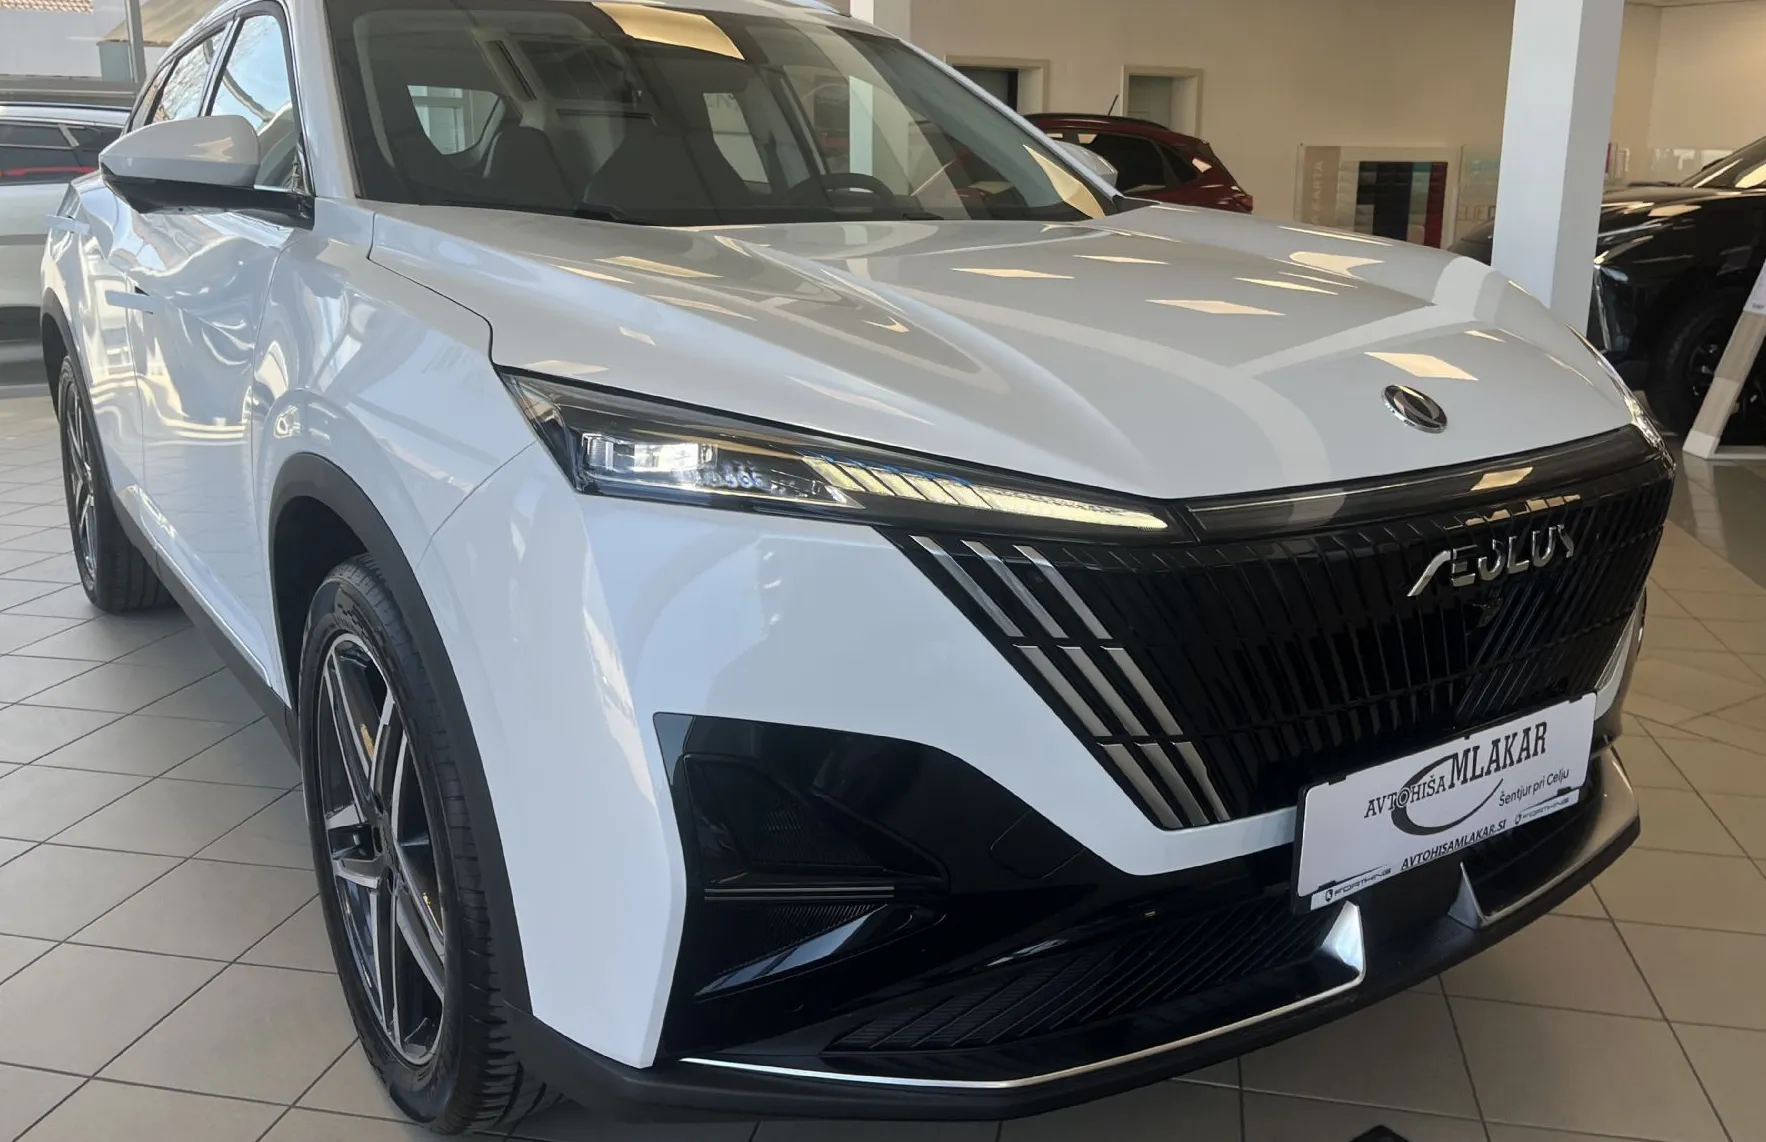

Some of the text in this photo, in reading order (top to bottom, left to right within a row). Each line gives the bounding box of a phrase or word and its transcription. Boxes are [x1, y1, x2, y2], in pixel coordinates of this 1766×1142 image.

[1363, 721, 1548, 818] AVTOHIŠA MLAKAR
[1498, 767, 1570, 807] Šentjur pri Celju
[1401, 819, 1507, 871] AVTOHISAMLAKAR.SI
